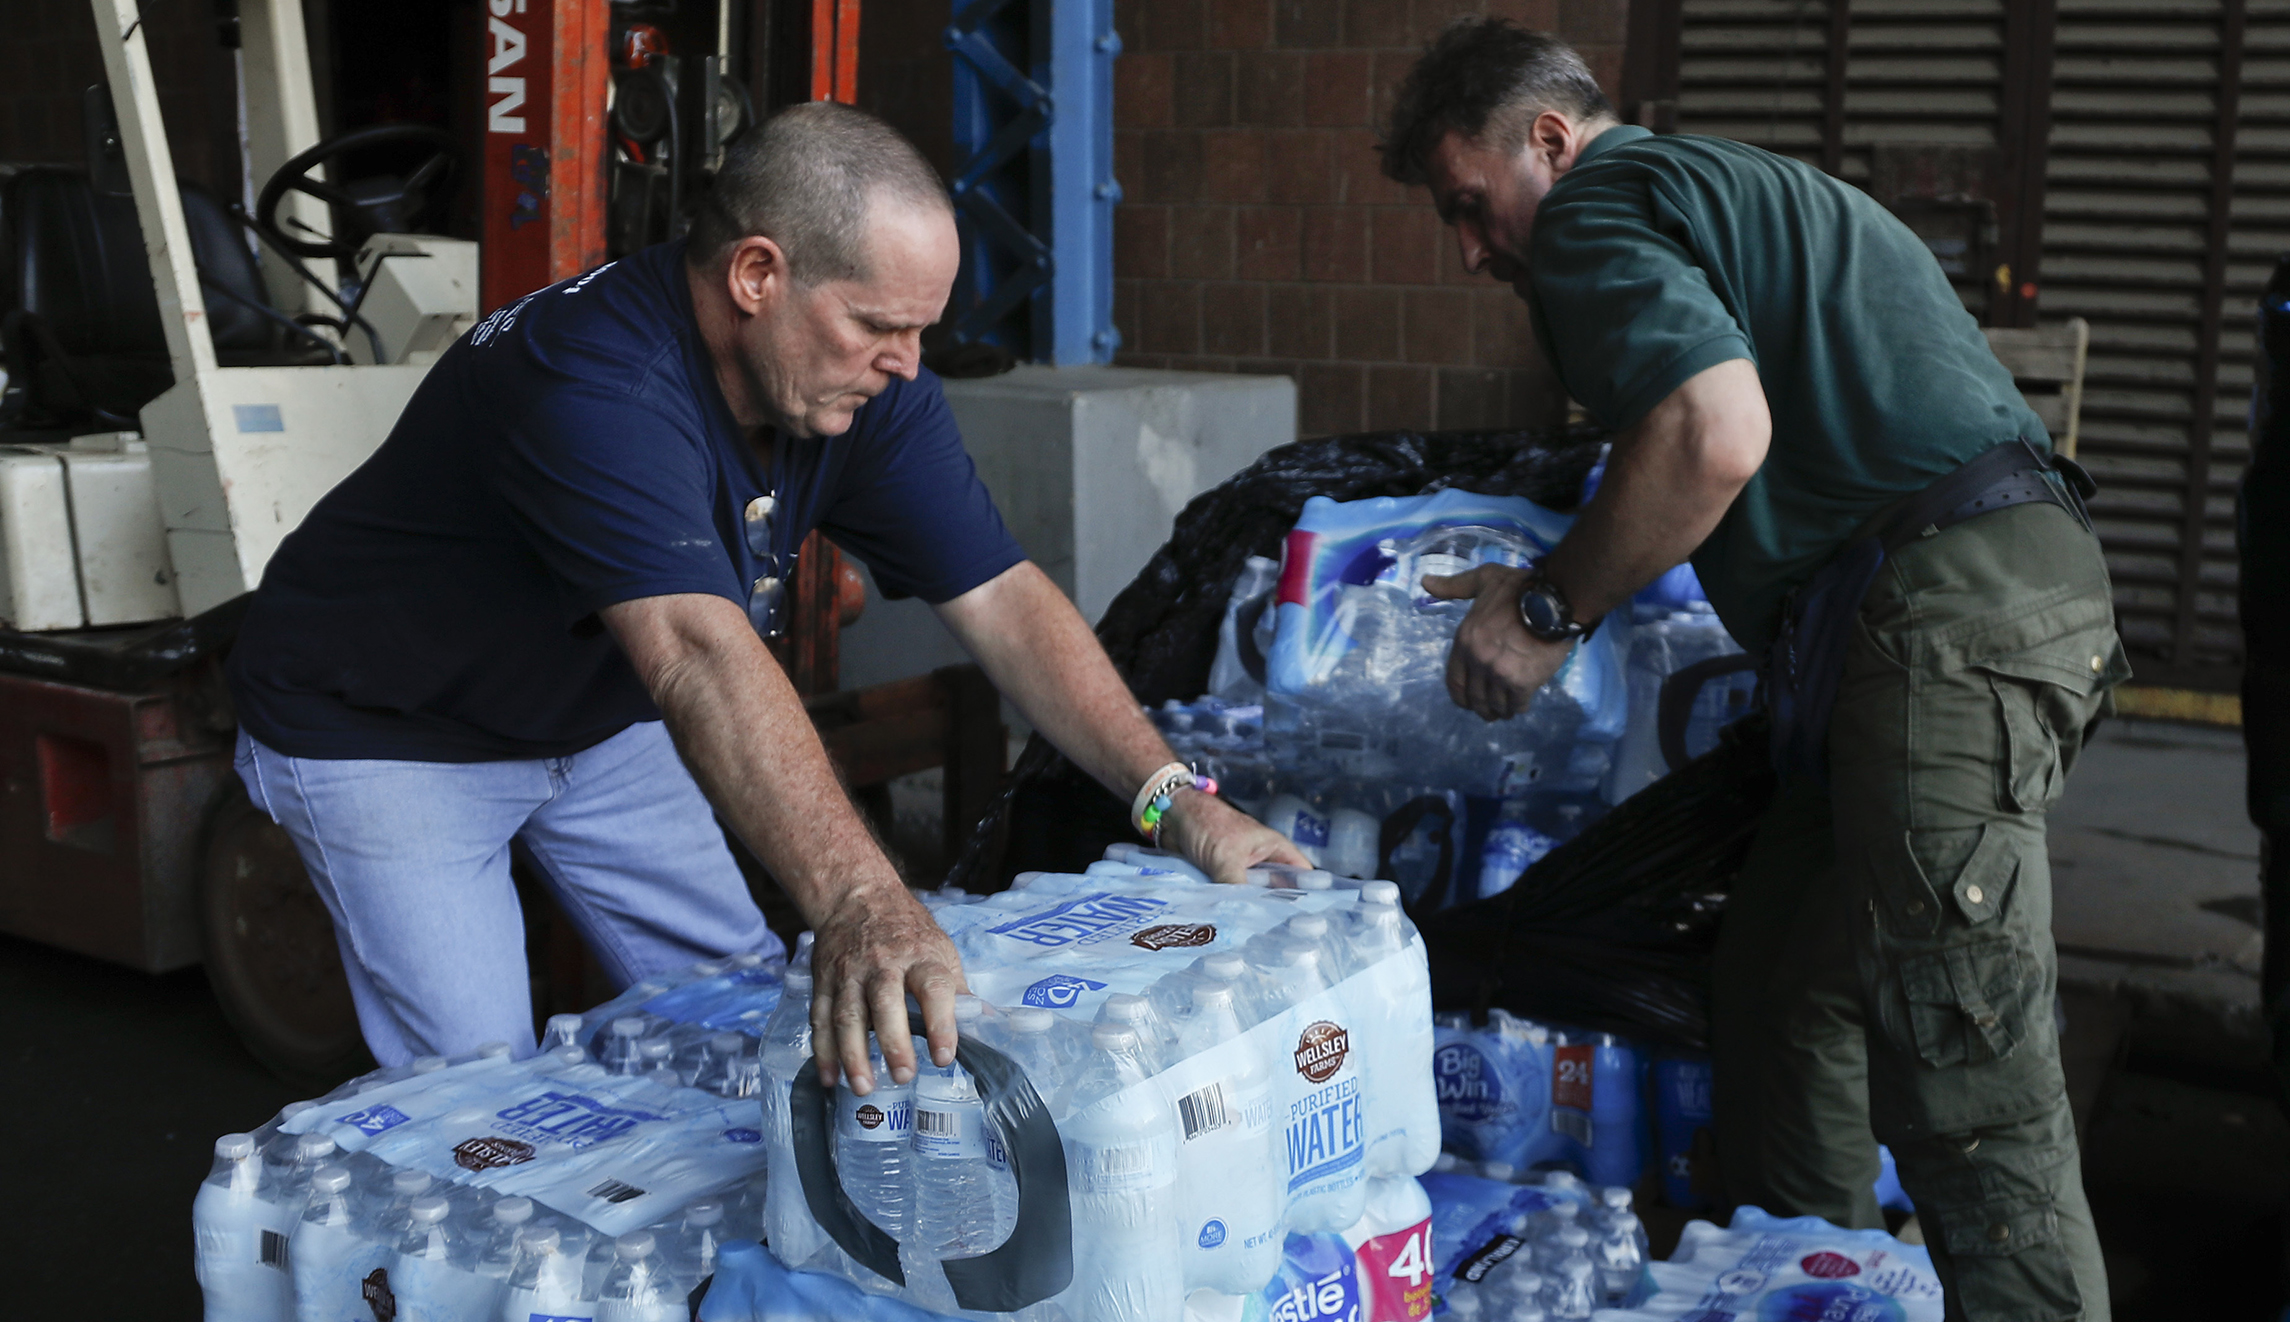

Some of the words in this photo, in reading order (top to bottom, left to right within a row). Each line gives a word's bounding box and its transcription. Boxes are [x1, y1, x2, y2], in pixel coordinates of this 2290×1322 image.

[1296, 1036, 1347, 1069] WELLSLEY
[1310, 1058, 1337, 1075] FARMS
[1438, 1047, 1481, 1079] Big
[1437, 1073, 1488, 1101] Win
[1558, 1059, 1588, 1086] 24
[1290, 1076, 1358, 1121] PURIFIED
[1286, 1091, 1364, 1176] WATER
